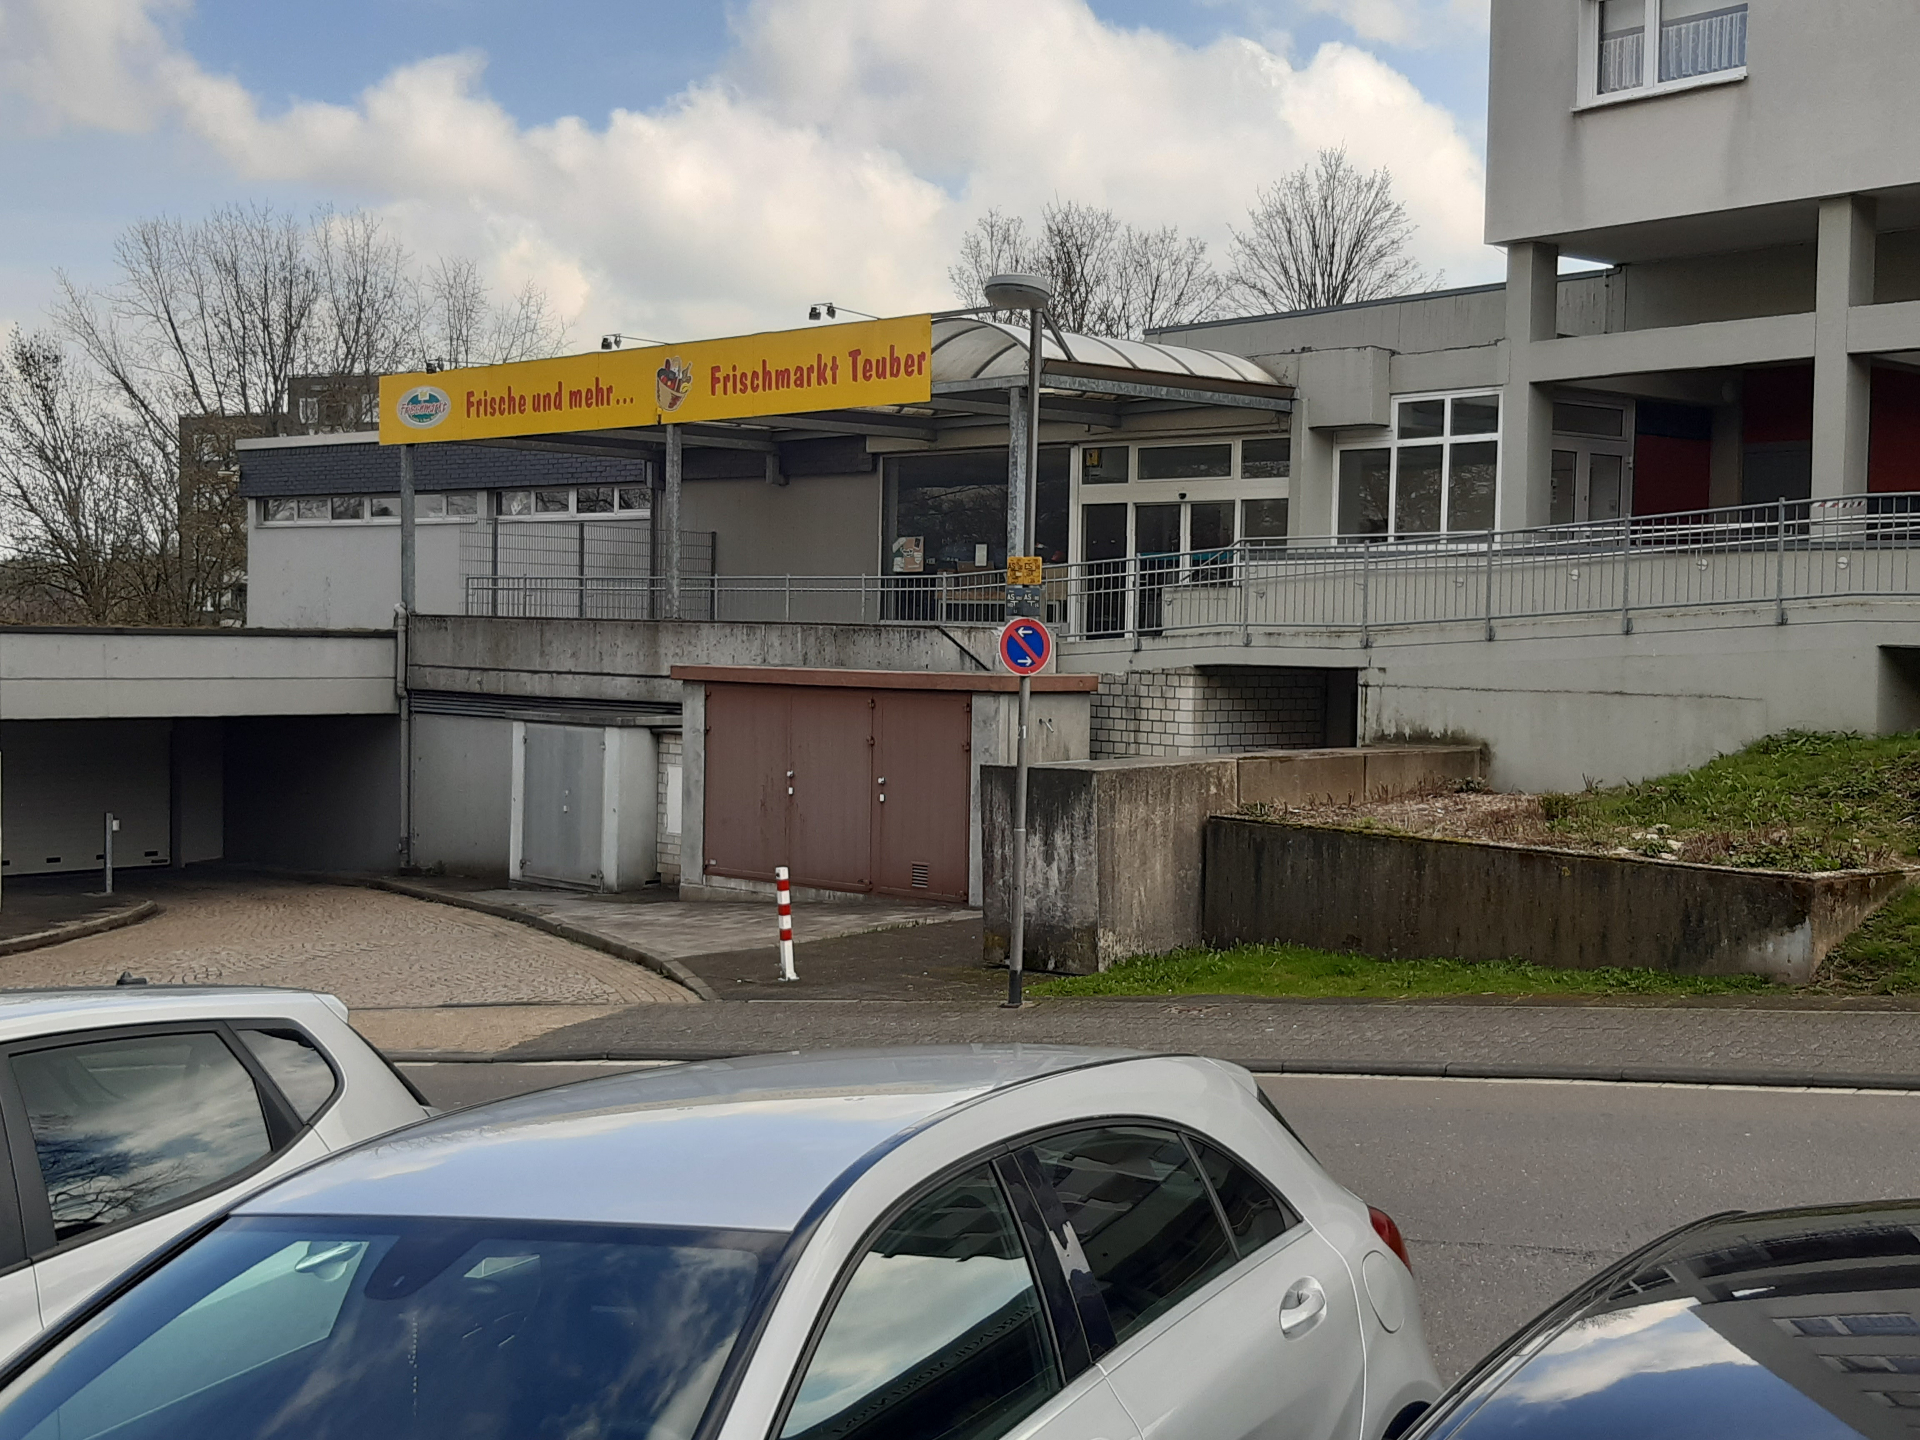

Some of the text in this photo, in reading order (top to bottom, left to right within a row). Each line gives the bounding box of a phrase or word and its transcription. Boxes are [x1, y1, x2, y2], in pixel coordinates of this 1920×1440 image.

[710, 344, 926, 396] Frischmarkt Teuber
[466, 376, 634, 418] Frische und mehr...
[1007, 593, 1015, 601] AS
[1023, 593, 1032, 601] AS
